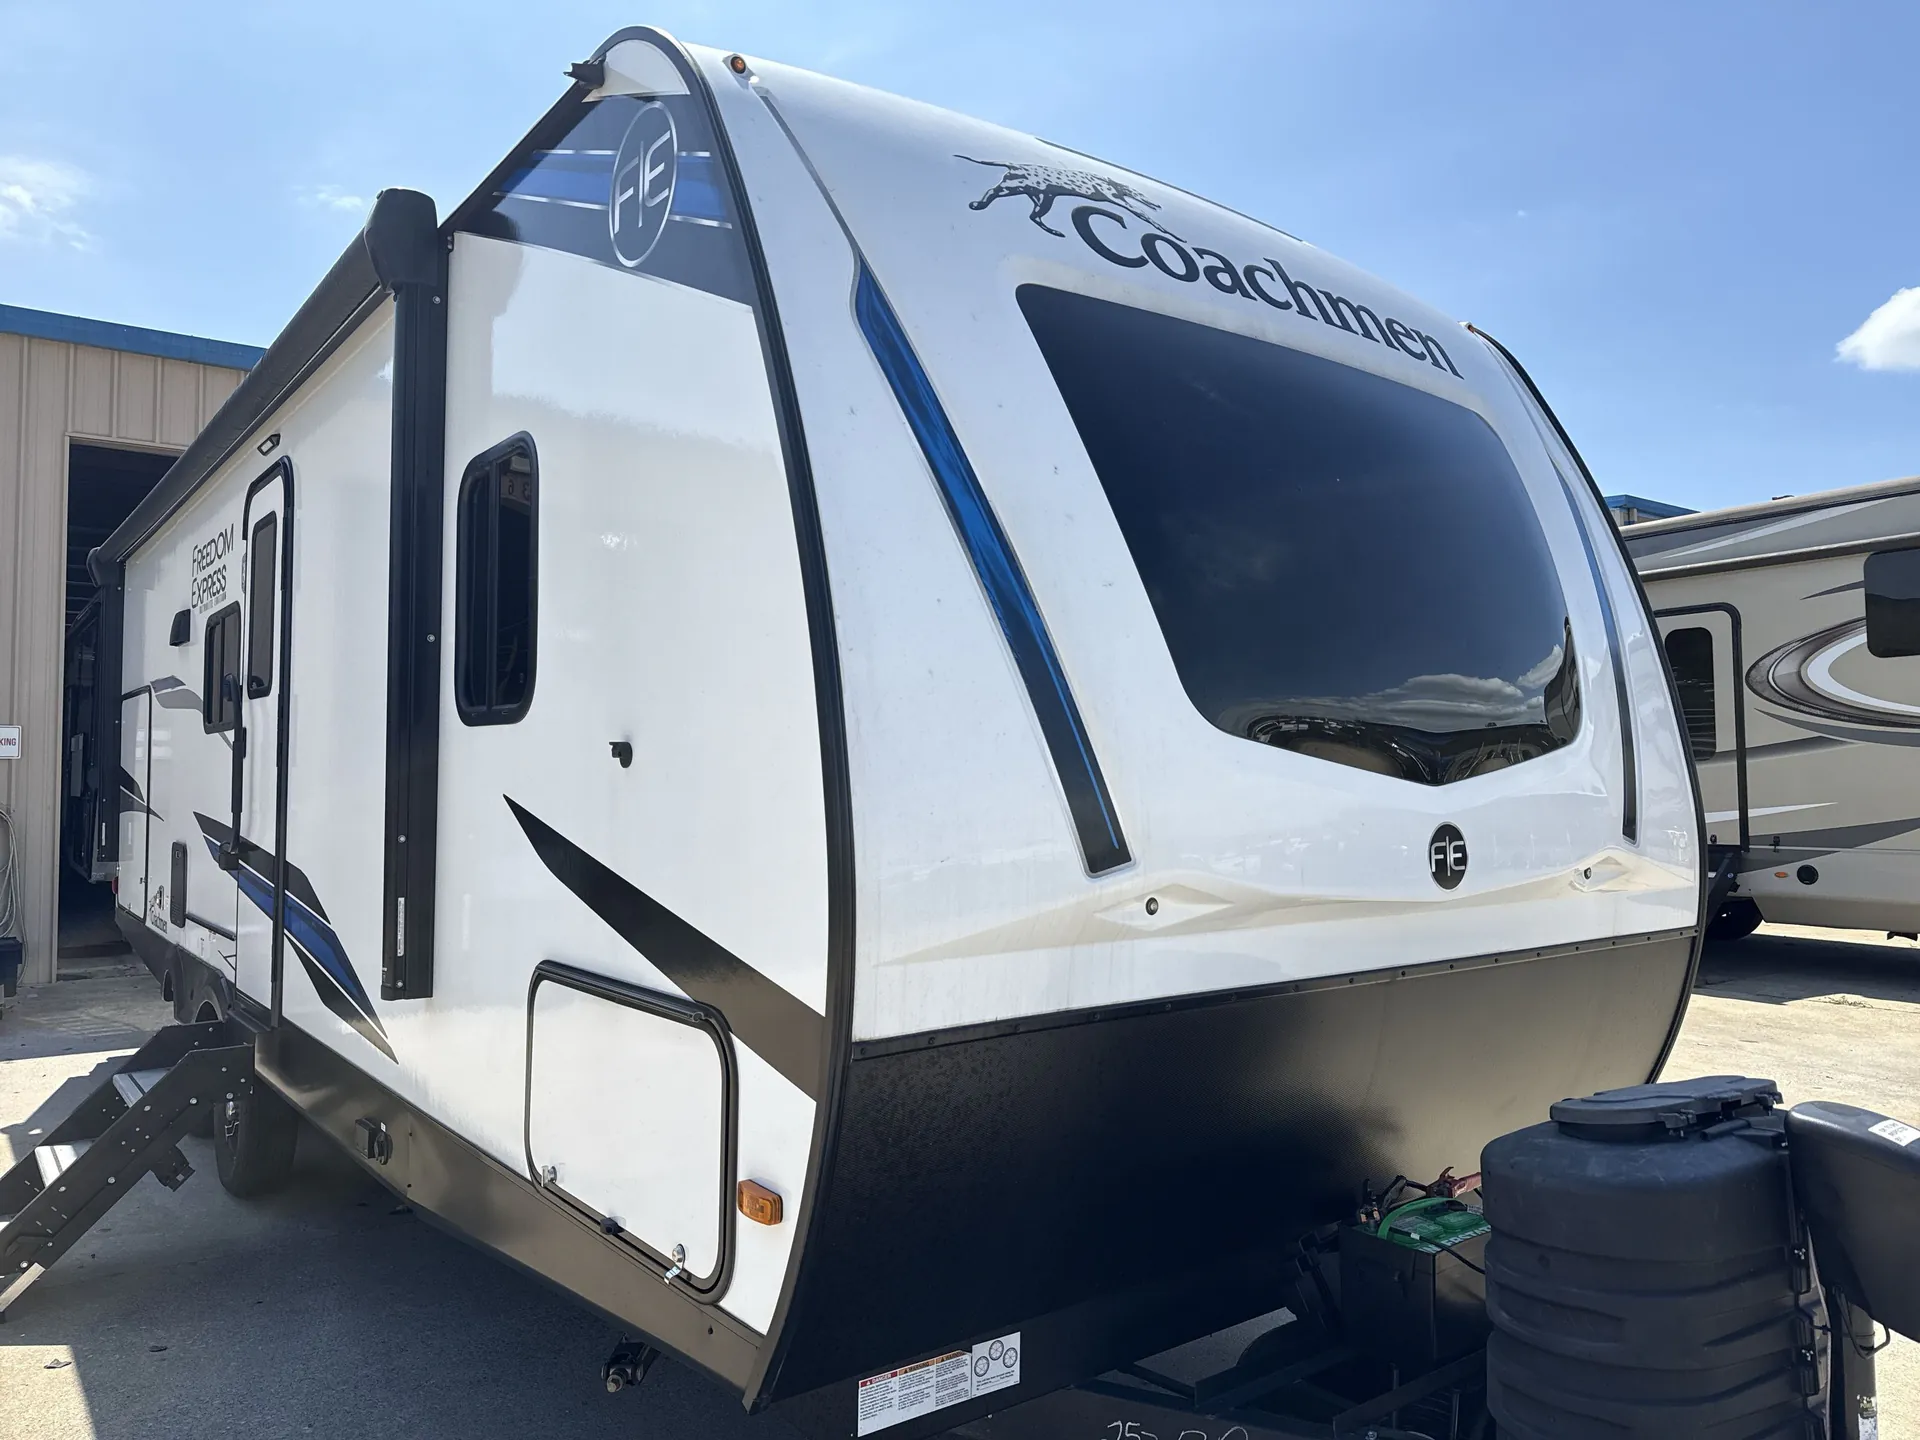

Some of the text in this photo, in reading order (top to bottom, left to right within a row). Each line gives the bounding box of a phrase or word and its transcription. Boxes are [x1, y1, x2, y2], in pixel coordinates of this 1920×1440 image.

[1071, 205, 1464, 380] Coachmen
[192, 523, 234, 577] FREEDOM
[192, 564, 227, 609] EXPRESS
[872, 1373, 892, 1384] DANGER
